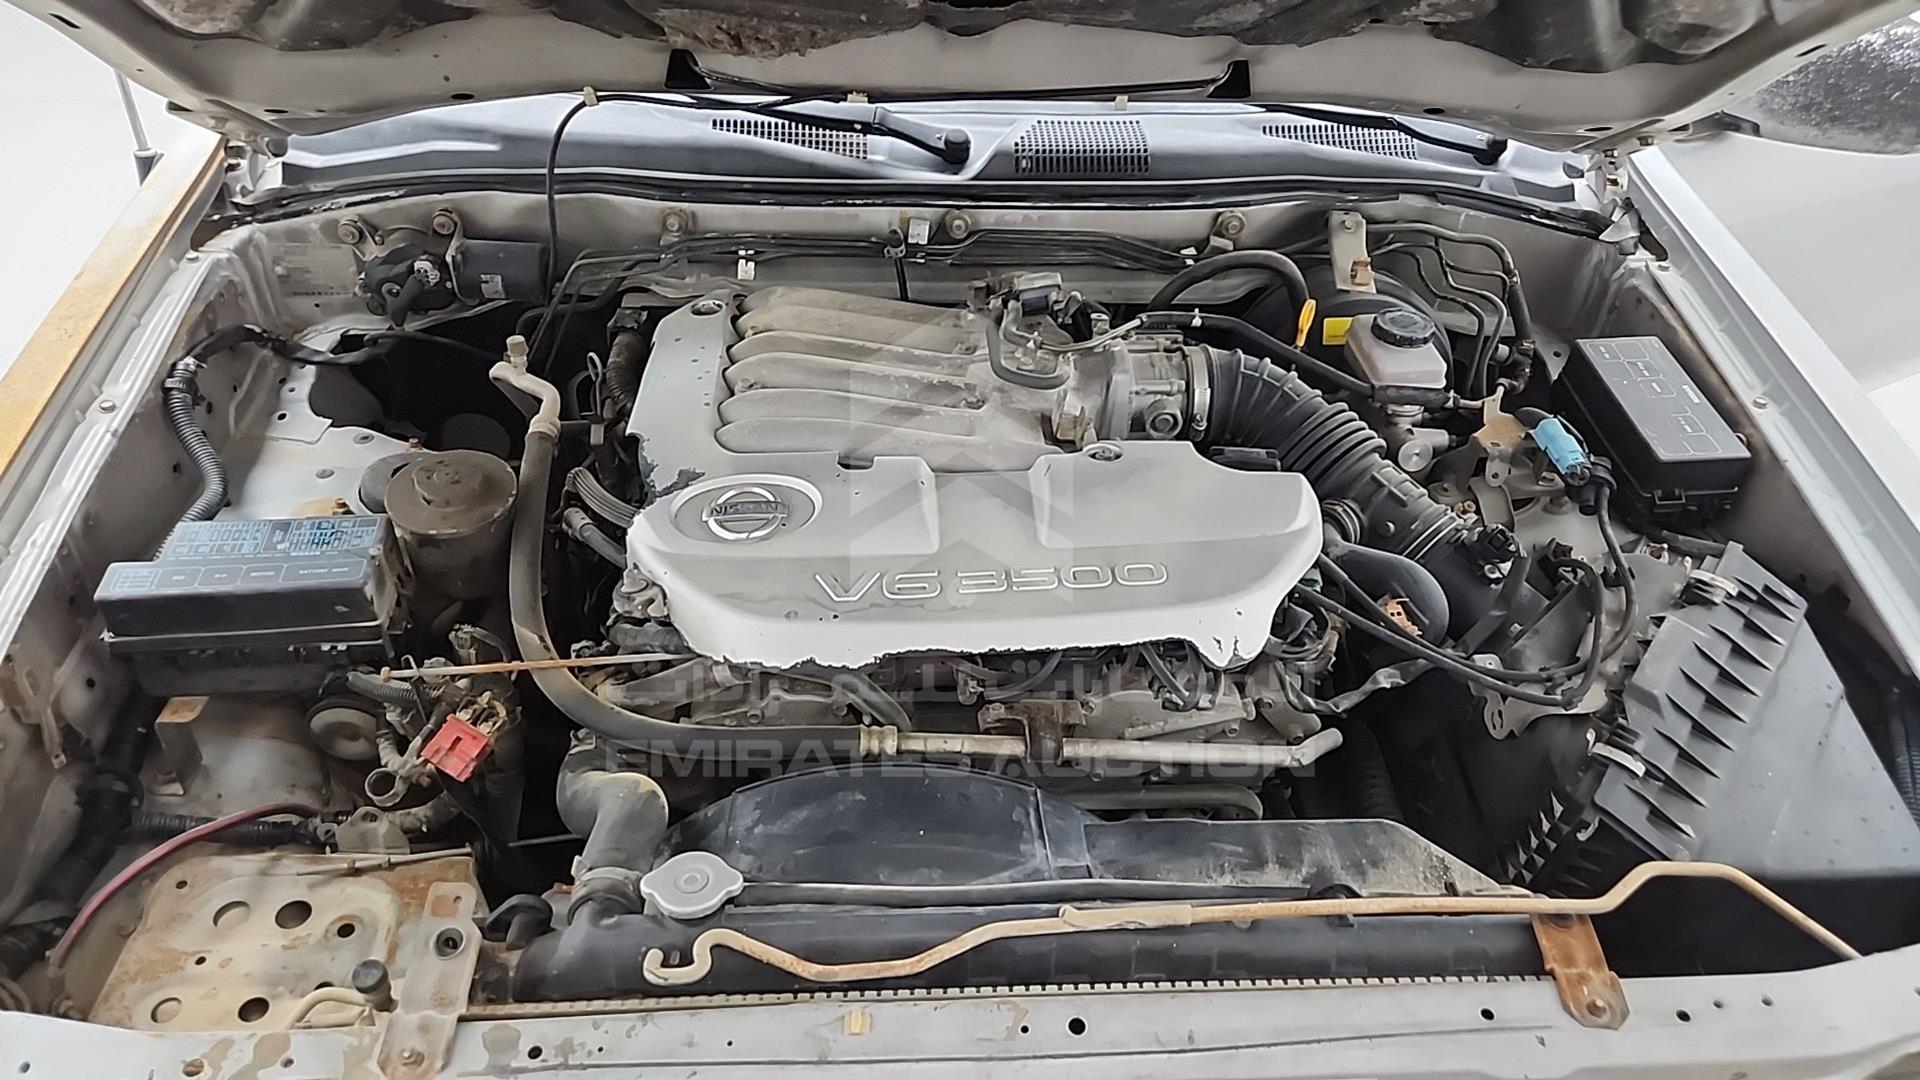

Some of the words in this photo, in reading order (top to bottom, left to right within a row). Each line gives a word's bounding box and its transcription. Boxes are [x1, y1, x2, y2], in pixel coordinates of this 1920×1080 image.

[710, 502, 779, 516] NISSAN
[815, 569, 943, 602] V6
[955, 563, 1168, 594] 3500
